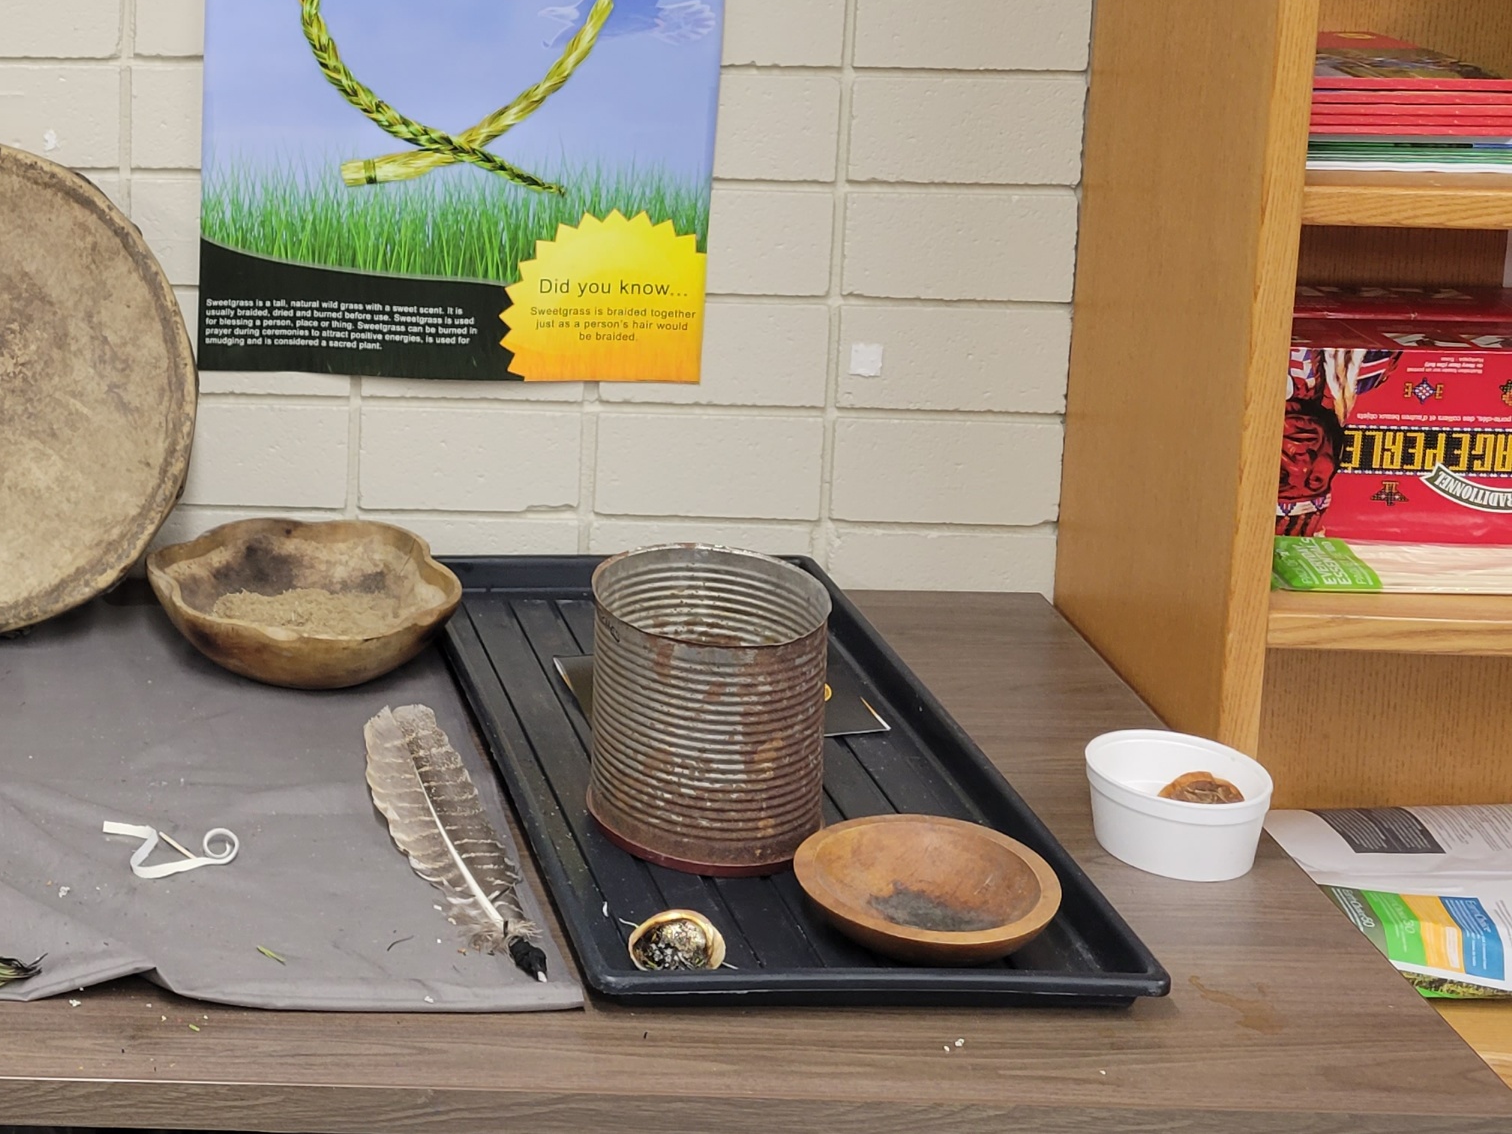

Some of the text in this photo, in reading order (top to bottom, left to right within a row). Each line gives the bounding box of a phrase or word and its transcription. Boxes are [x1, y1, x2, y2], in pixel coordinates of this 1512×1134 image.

[539, 278, 688, 298] Did you know...
[530, 306, 696, 321] Sweetgrass is braided together
[536, 318, 554, 330] just
[558, 320, 570, 328] as
[583, 321, 628, 331] person's
[632, 320, 653, 330] hair
[656, 321, 688, 330] would
[205, 336, 244, 348] smudging
[246, 338, 262, 346] and
[264, 338, 271, 346] is
[273, 338, 319, 347] considered
[328, 340, 357, 349] sacred
[358, 341, 382, 352] plant.
[579, 331, 638, 341] be braided.
[1449, 433, 1512, 471] AGE
[1434, 470, 1512, 507] RADITIONNEL
